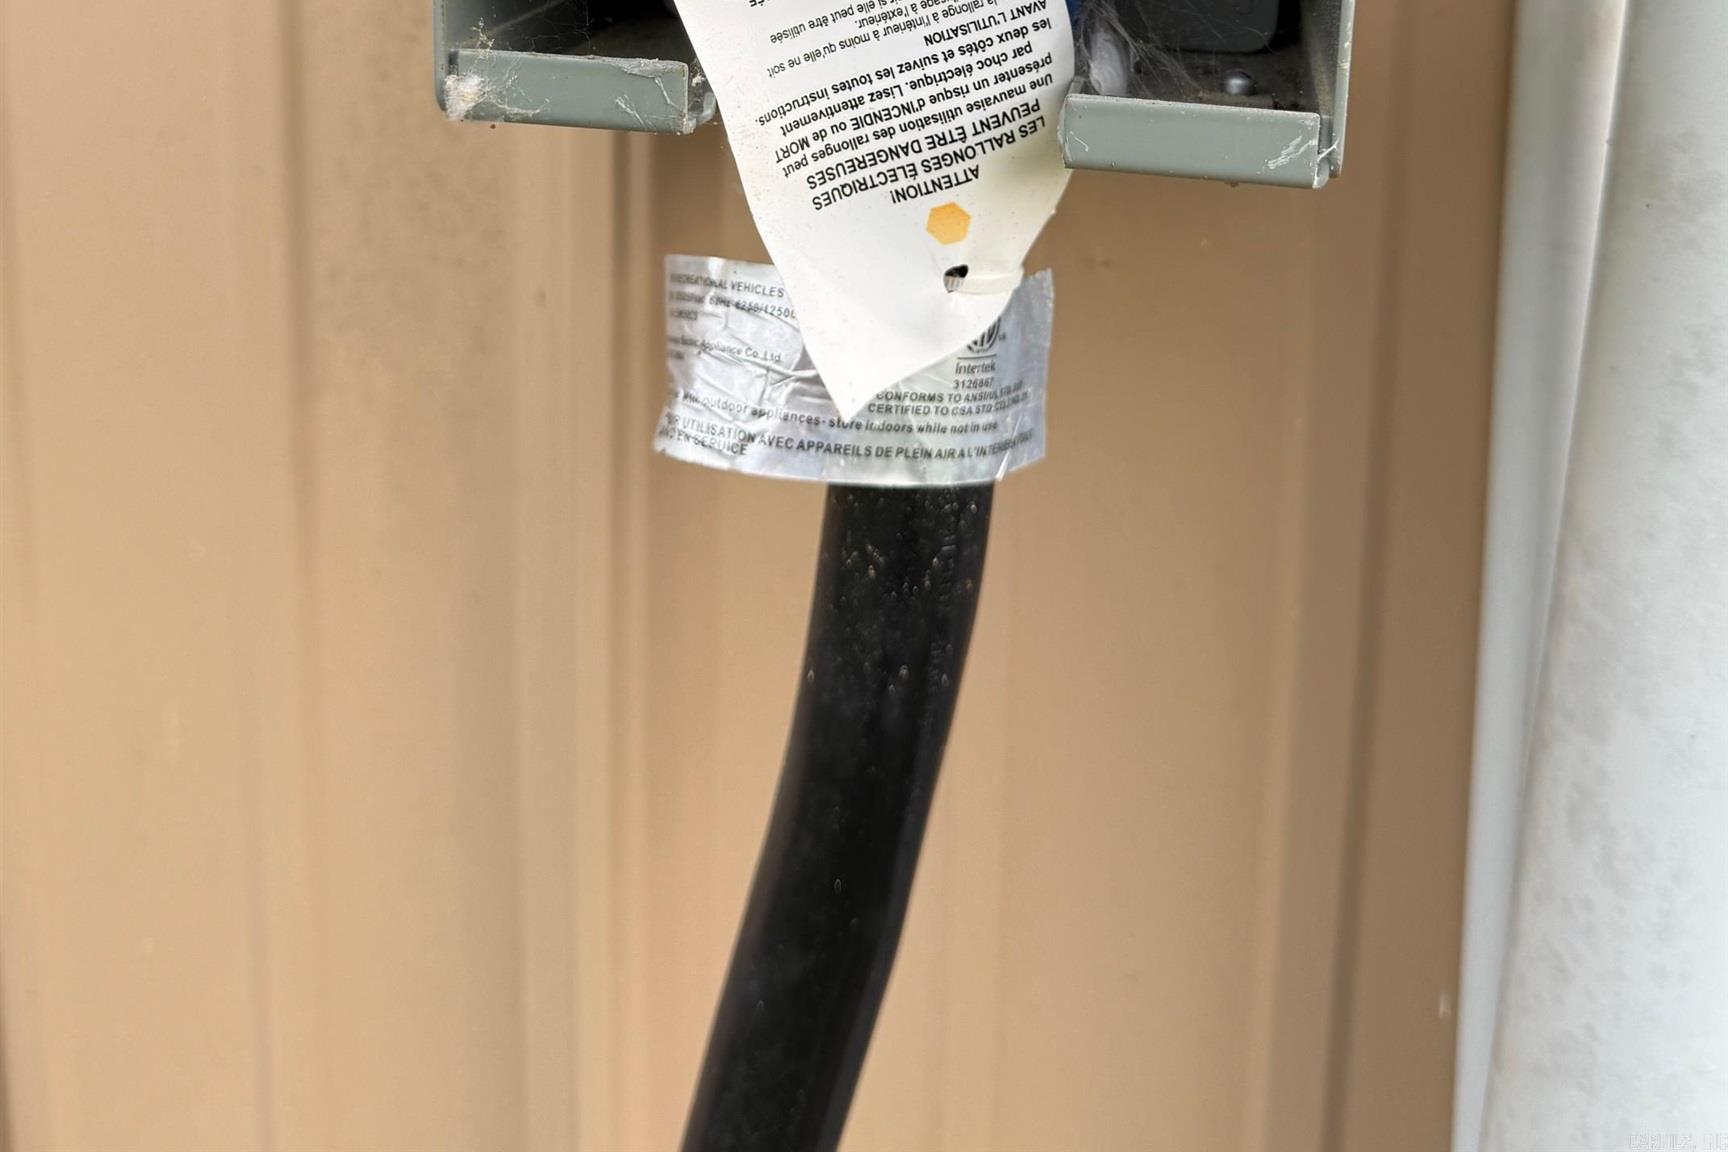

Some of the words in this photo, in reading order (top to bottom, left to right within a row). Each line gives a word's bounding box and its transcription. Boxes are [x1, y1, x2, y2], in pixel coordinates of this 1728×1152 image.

[830, 4, 855, 23] peut
[856, 0, 875, 14] elle
[910, 3, 918, 14] à
[808, 15, 829, 29] être
[855, 6, 909, 29] l'extérieur.
[883, 15, 931, 36] l'intérieur
[932, 12, 940, 24] à
[1032, 17, 1052, 32] les
[770, 24, 806, 43] utilisée
[872, 30, 880, 41] à
[923, 12, 1007, 46] L'UTILISATION
[996, 26, 1029, 44] deux
[838, 33, 871, 50] moins
[958, 37, 994, 57] côtés
[1012, 40, 1033, 59] par
[803, 42, 836, 62] qu'elle
[941, 49, 955, 63] et
[976, 52, 1008, 70] choc
[767, 63, 786, 77] soit
[788, 57, 801, 68] ne
[896, 54, 939, 74] suivez
[994, 52, 1053, 85] présenter
[831, 73, 873, 94] toutes
[875, 67, 896, 80] les
[905, 63, 973, 90] électrique.
[1029, 73, 1053, 90] Une
[867, 84, 904, 103] Lisez
[929, 84, 970, 104] risque
[972, 78, 990, 91] un
[755, 88, 832, 126] instructions.
[966, 84, 1027, 113] mauvaise
[780, 95, 865, 137] attentivement
[849, 98, 926, 131] d'INCENDIE
[899, 106, 963, 133] utilisation
[972, 98, 1044, 137] PEUVENT
[812, 128, 827, 142] de
[830, 121, 847, 134] ou
[872, 126, 896, 140] des
[1018, 115, 1045, 138] LES
[924, 125, 968, 150] ÊTRE
[775, 136, 810, 163] MORT
[811, 134, 870, 162] rallonges
[921, 129, 1016, 173] RALLONGES
[778, 154, 809, 178] peut
[806, 139, 923, 190] DANGEREUSES
[812, 162, 919, 211] ÉLECTRIQUES
[890, 164, 979, 204] ATTENTION!
[730, 280, 785, 298] VEHICLES
[954, 359, 996, 375] Intertek
[875, 386, 944, 408] CONFORMS
[947, 391, 962, 403] TO
[866, 397, 930, 420] CERTIFIED
[932, 402, 949, 416] TO
[950, 404, 973, 417] CSA
[828, 414, 862, 431] store
[916, 420, 948, 436] while
[949, 423, 969, 434] not
[969, 421, 980, 431] in
[682, 414, 757, 444] UTILISATION
[757, 431, 795, 451] AVEC
[795, 437, 873, 458] APPAREILS
[874, 445, 893, 458] DE
[894, 445, 933, 462] PLEIN
[934, 445, 957, 460] AIR
